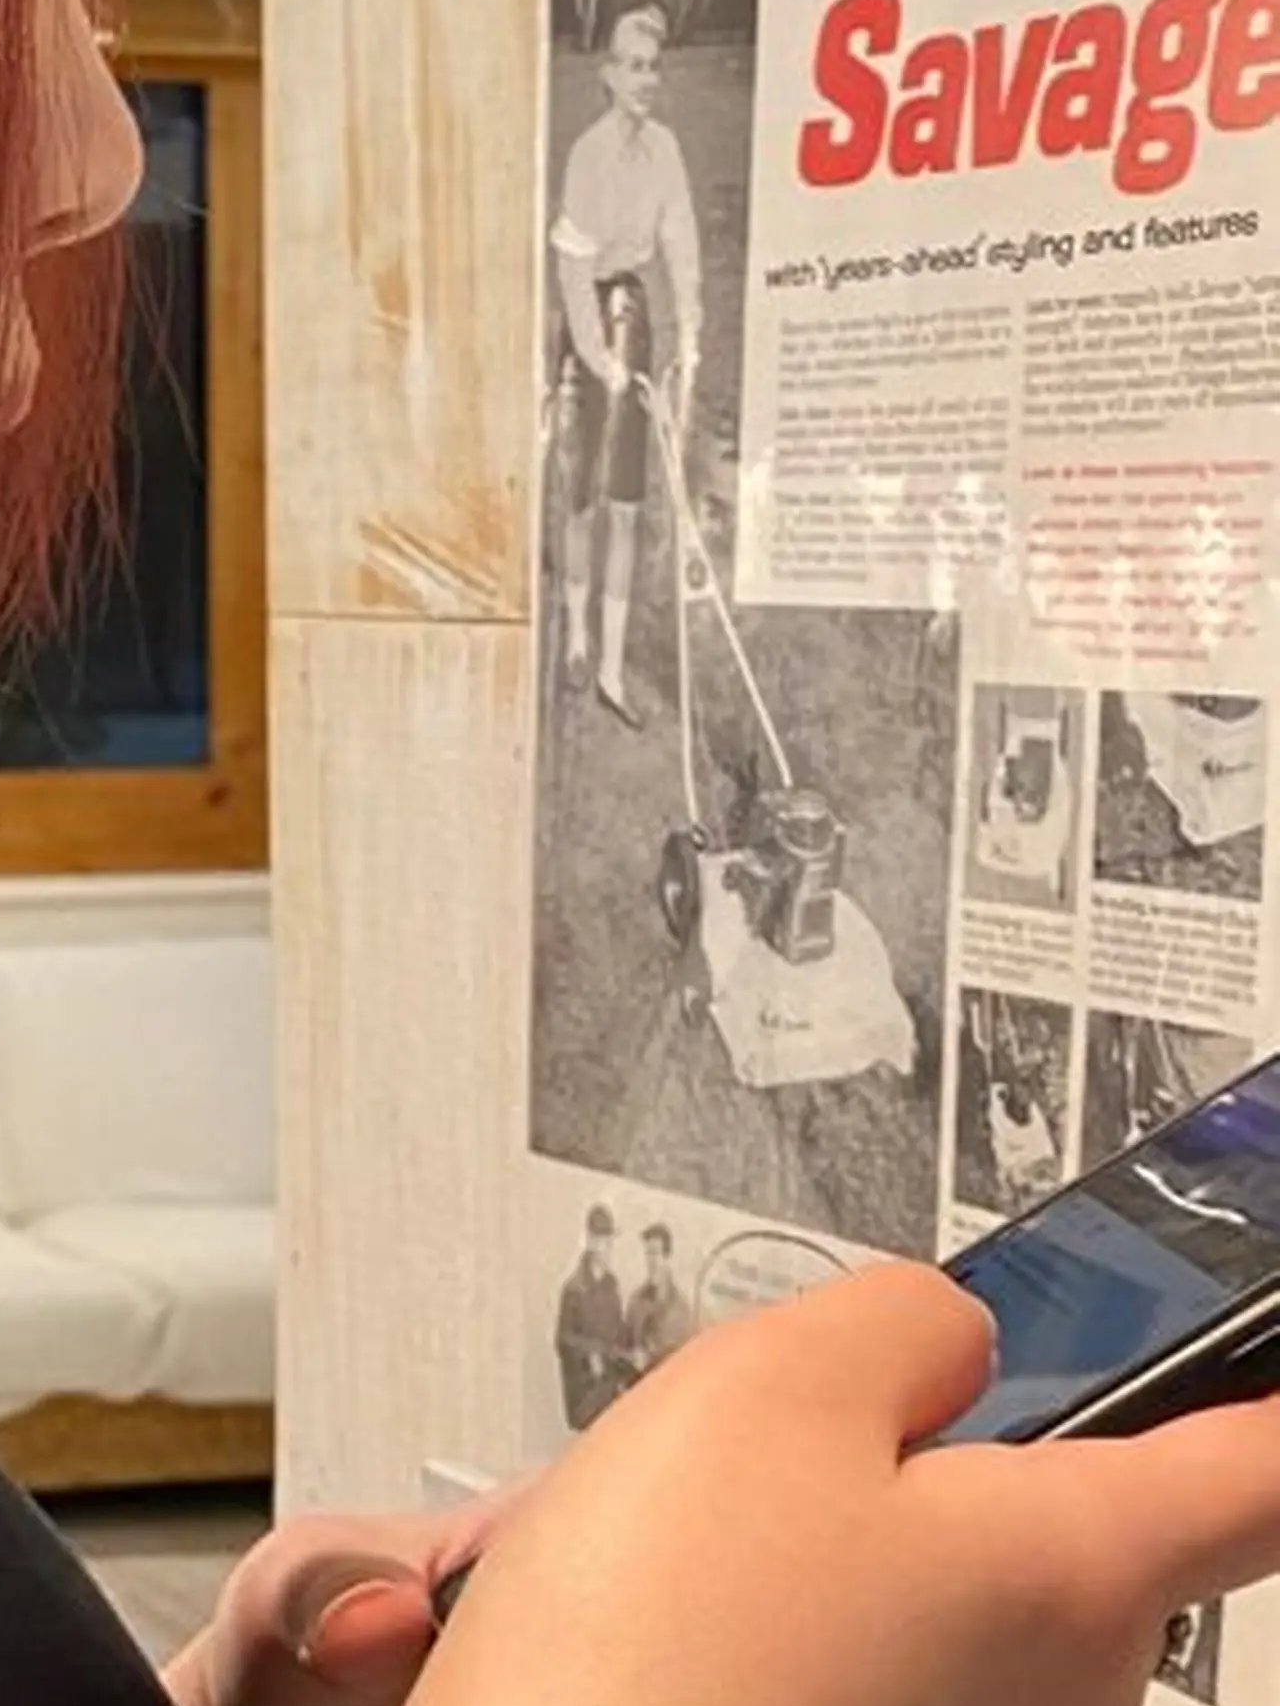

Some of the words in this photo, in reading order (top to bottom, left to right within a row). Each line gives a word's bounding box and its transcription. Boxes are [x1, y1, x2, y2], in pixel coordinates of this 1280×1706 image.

[987, 228, 1075, 274] styling
[1082, 220, 1138, 255] and
[1143, 209, 1260, 249] features
